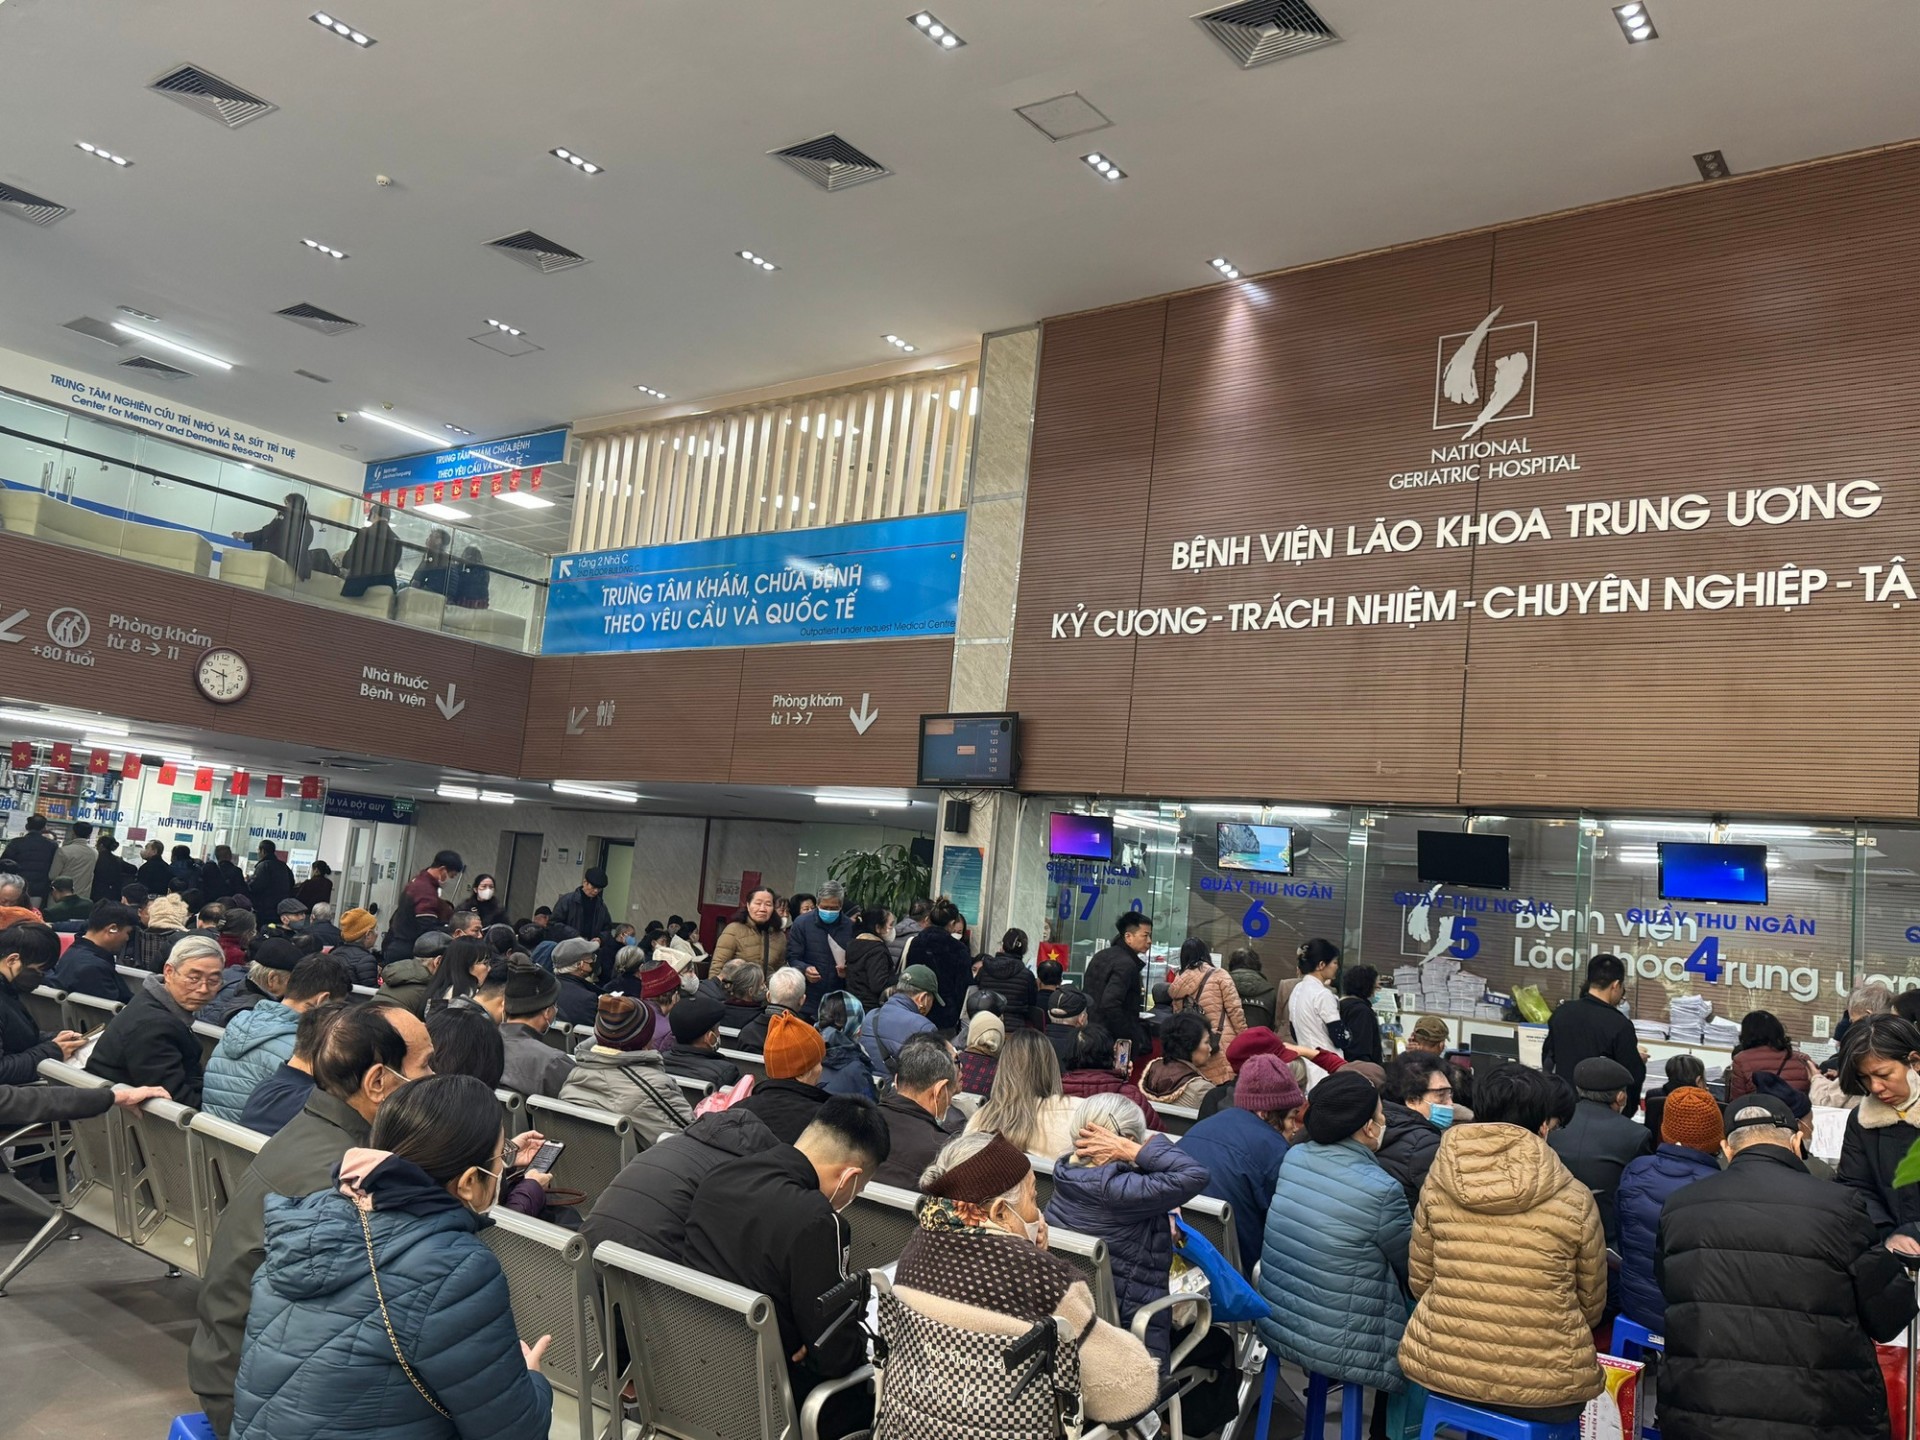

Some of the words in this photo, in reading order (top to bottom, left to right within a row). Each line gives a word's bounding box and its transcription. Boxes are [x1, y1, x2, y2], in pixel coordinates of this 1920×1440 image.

[50, 374, 85, 392] TRUNG
[89, 386, 111, 401] TÂM
[113, 394, 152, 414] NGHIÊN
[154, 407, 175, 421] CỨU
[178, 414, 191, 426] TRÍ
[193, 419, 215, 433] NHỚ
[217, 426, 231, 438] VÀ
[233, 432, 246, 443] SA
[248, 436, 264, 448] SÚT
[267, 442, 279, 453] TRÍ
[280, 446, 296, 460] TUỆ
[71, 394, 106, 411] Center
[108, 405, 122, 416] for
[124, 409, 164, 430] Memory
[165, 424, 184, 435] and
[185, 429, 230, 449] Dementia
[232, 443, 274, 462] Research
[1431, 437, 1531, 464] NATIONAL
[437, 469, 453, 479] THEO
[1388, 464, 1480, 490] GERIATRIC
[1488, 454, 1581, 479] HOSPITAL
[1171, 534, 1251, 574] BỆNH
[1259, 524, 1334, 566] VIỆN
[1346, 517, 1423, 555] LÃO
[1436, 507, 1553, 548] KHOA
[1566, 494, 1711, 539] TRUNG
[1726, 479, 1883, 528] ƯƠNG
[578, 558, 596, 569] Tầng
[597, 557, 603, 567] 2
[604, 555, 620, 566] Nhà
[621, 553, 629, 564] C
[601, 585, 653, 607] TRUNG
[657, 577, 691, 602] TÂM
[695, 571, 750, 599] KHÁM,
[754, 566, 807, 595] CHỮA
[812, 563, 863, 594] BỆNH
[604, 613, 646, 634] THEO
[650, 607, 682, 631] YÊU
[687, 600, 728, 629] CẦU
[732, 598, 760, 626] VÀ
[766, 592, 829, 624] QUỐC
[834, 588, 858, 620] TẾ
[1051, 602, 1088, 639] KỶ
[1094, 605, 1208, 637] CƯƠNG
[1228, 592, 1335, 631] TRÁCH
[1346, 585, 1457, 629] NHIỆM
[1482, 572, 1650, 619] CHUYÊN
[1663, 562, 1828, 612] NGHIỆP
[108, 613, 163, 640] Phòng
[165, 626, 212, 648] khám
[800, 625, 839, 638] Outpatient
[840, 624, 863, 634] under
[863, 623, 892, 635] request
[894, 620, 926, 631] Medical
[927, 619, 956, 629] Centre
[31, 645, 62, 661] +80
[65, 650, 96, 667] tuổi
[107, 633, 127, 650] từ
[129, 638, 142, 653] 8
[167, 645, 180, 660] 11
[362, 665, 390, 682] Nhà
[393, 672, 430, 690] thuốc
[360, 682, 394, 701] Bệnh
[398, 693, 426, 708] viện
[772, 693, 808, 710] Phòng
[809, 692, 843, 707] khám
[771, 712, 783, 725] từ
[786, 712, 791, 725] 1
[805, 712, 813, 725] 7
[158, 817, 173, 827] NƠI
[176, 819, 192, 830] THU
[277, 812, 283, 827] 1
[249, 827, 264, 838] NƠI
[265, 828, 288, 841] NHẬN
[1079, 885, 1100, 920] 7
[1249, 880, 1278, 896] THU
[1283, 881, 1333, 899] NGÂN
[1242, 900, 1270, 939] 6
[1452, 896, 1487, 912] THU
[1493, 897, 1552, 916] NGÂN
[1626, 903, 1688, 926] QUẦY
[1695, 912, 1737, 930] THU
[1745, 915, 1816, 936] NGÂN
[1449, 916, 1480, 959] 5
[1514, 936, 1581, 972] Lão
[1684, 936, 1723, 982] 4
